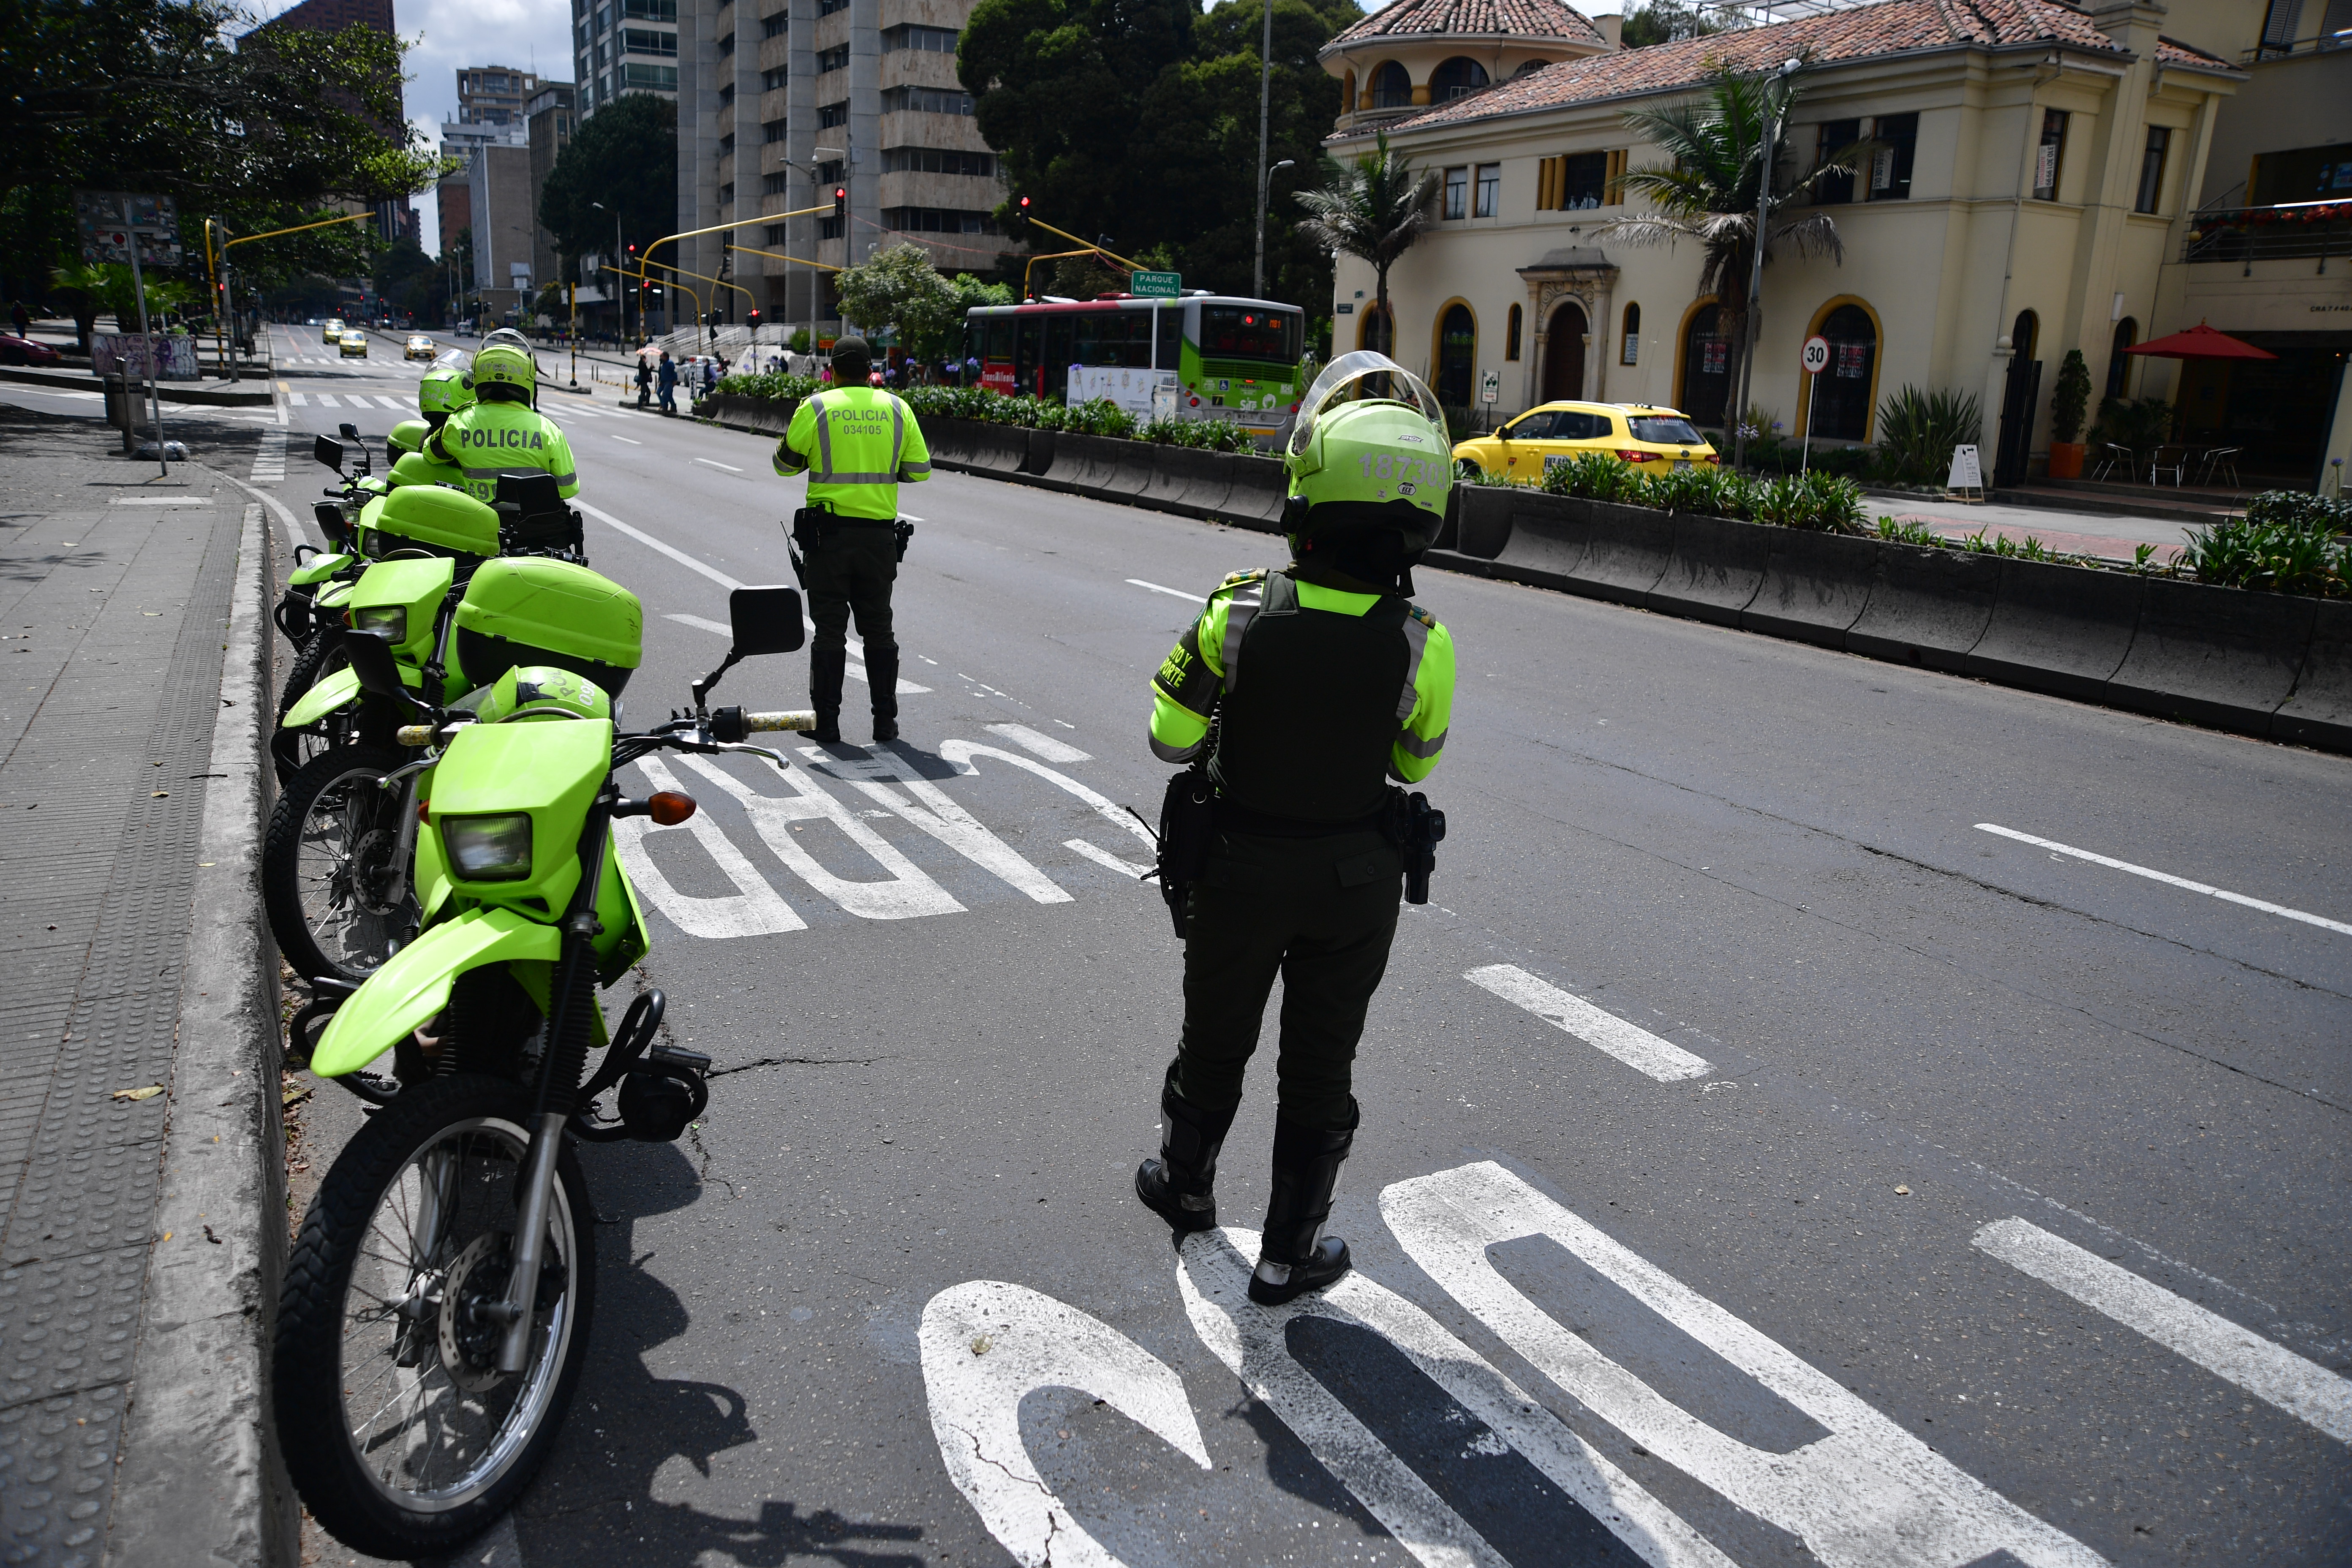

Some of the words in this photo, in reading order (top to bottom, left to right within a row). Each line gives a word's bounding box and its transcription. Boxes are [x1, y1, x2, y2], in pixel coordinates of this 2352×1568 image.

[1140, 275, 1173, 283] PARQUE
[1135, 285, 1177, 294] NACIONAL
[1807, 346, 1824, 363] 30
[982, 371, 1015, 382] TransMilenio
[832, 409, 889, 422] POLICIA
[843, 425, 882, 435] 034105
[461, 429, 542, 450] POLICIA
[1358, 452, 1446, 490] 187303
